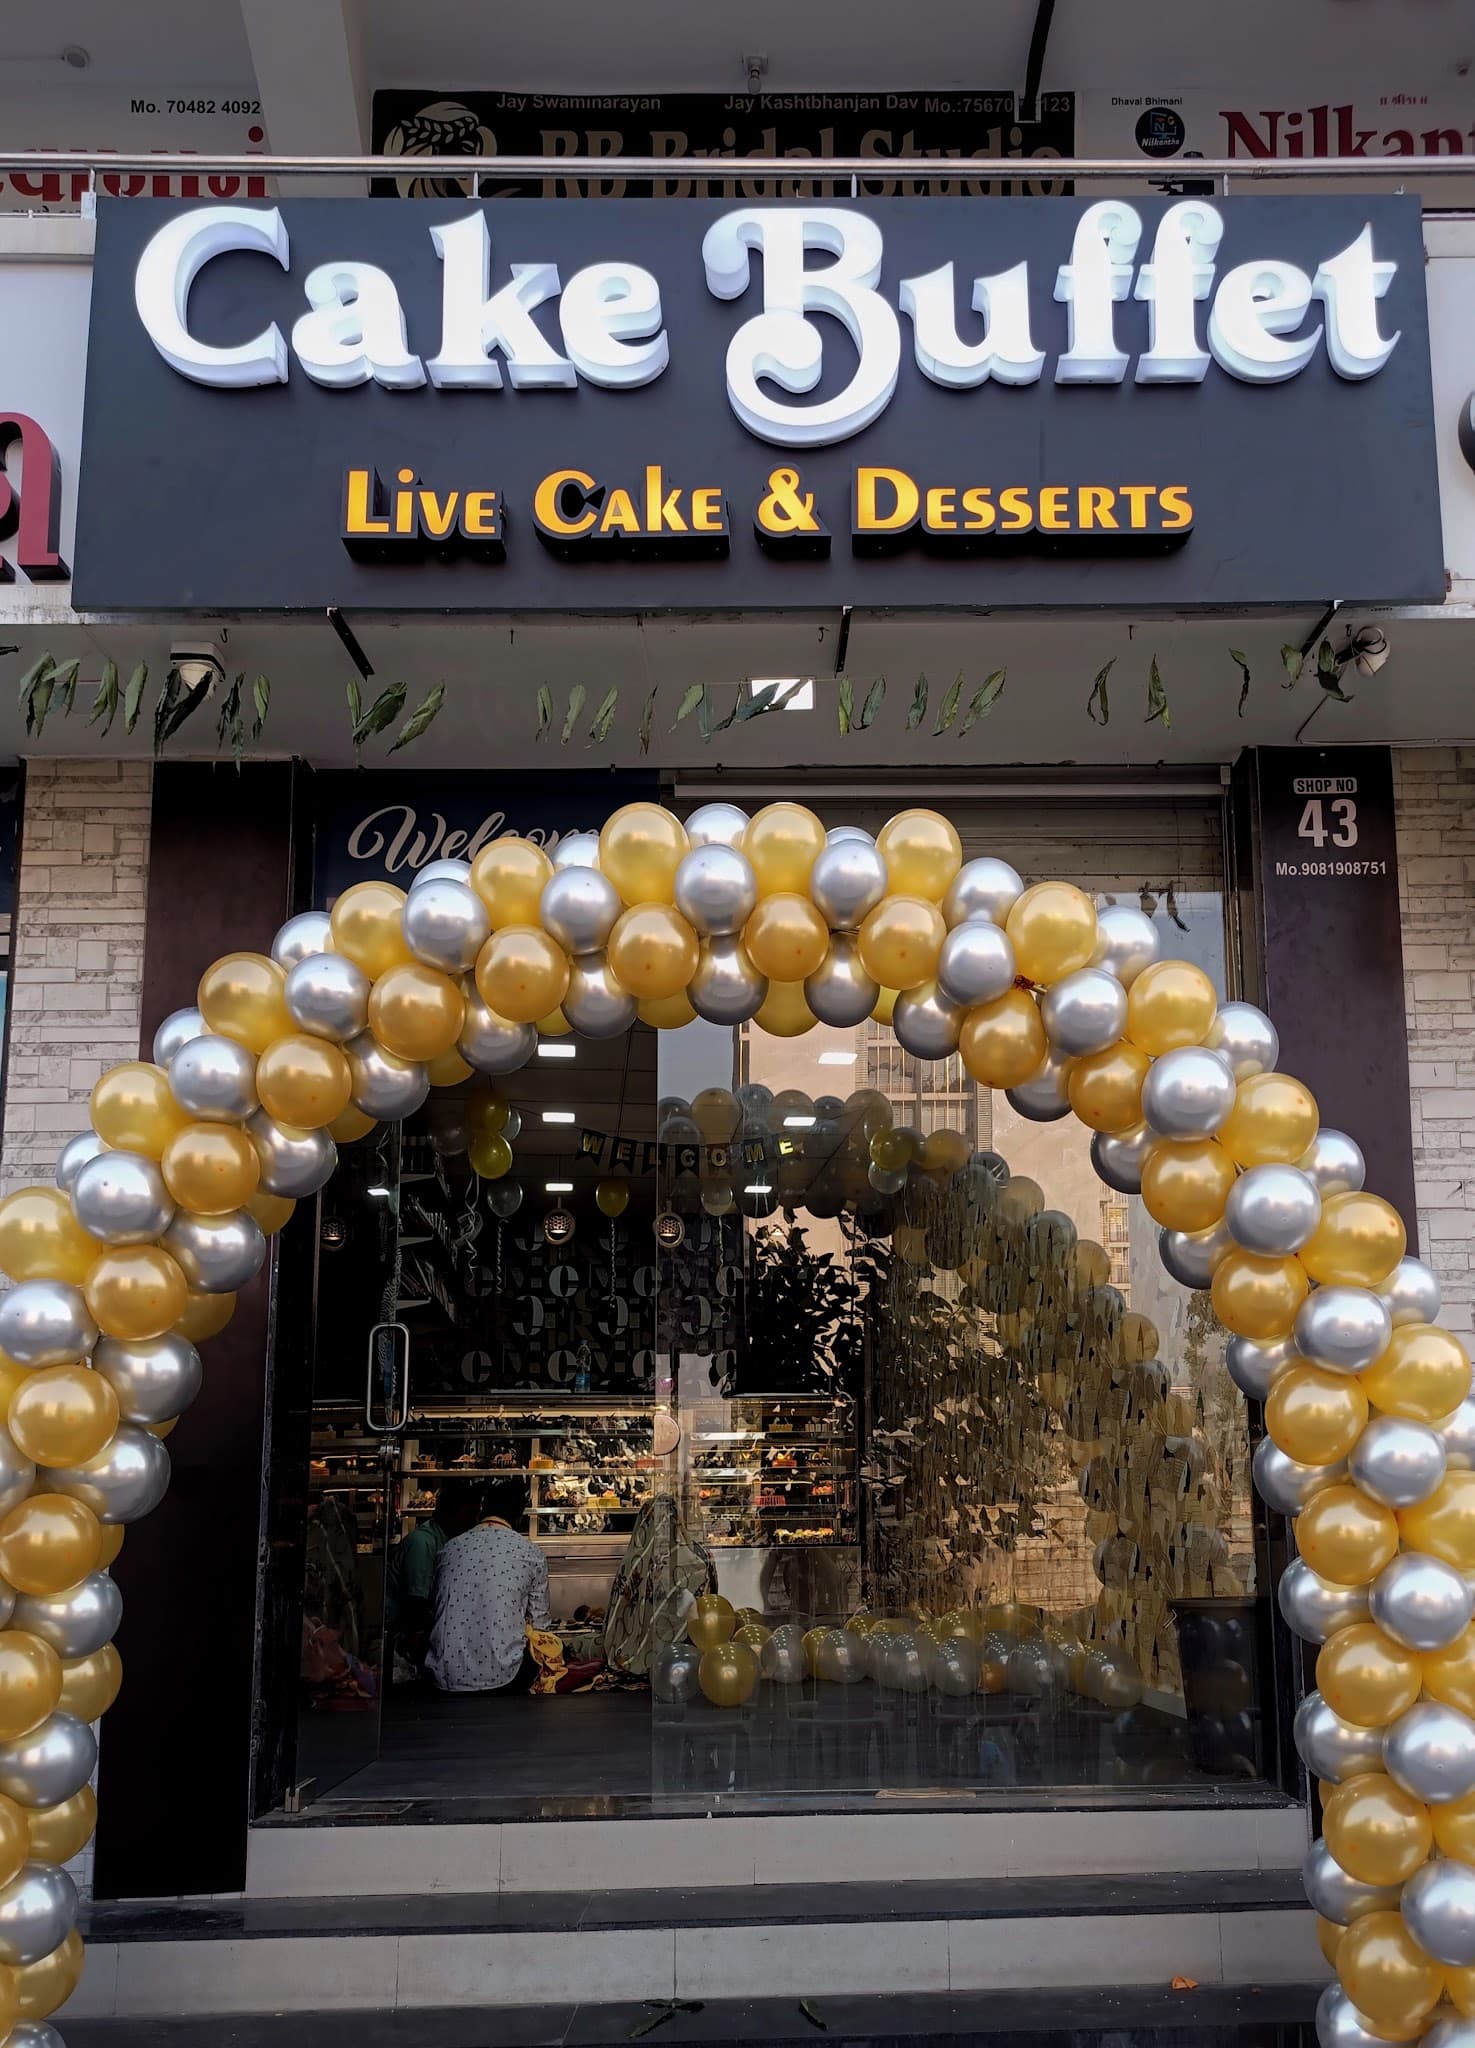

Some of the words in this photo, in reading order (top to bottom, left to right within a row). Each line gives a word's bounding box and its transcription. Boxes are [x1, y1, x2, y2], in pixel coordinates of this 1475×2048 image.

[131, 100, 161, 114] Mo.
[167, 99, 216, 115] 70482
[221, 100, 261, 115] 4092
[496, 95, 526, 110] Jay
[533, 94, 661, 111] Swaminarayan
[724, 95, 754, 112] Jay
[760, 95, 880, 111] Kashtbhanjan
[886, 95, 918, 109] Dav
[1111, 97, 1143, 106] Dhaval
[1145, 97, 1182, 106] Bhimani
[1218, 105, 1475, 160] Nilkan
[858, 127, 1067, 198] Studio
[134, 206, 670, 390] Cake
[704, 199, 1401, 448] Buffet
[757, 466, 820, 532] &
[1297, 779, 1331, 792] SHOP
[1336, 779, 1353, 791] NO
[1298, 798, 1358, 848] 43
[1275, 861, 1387, 876] Mo.9081908751
